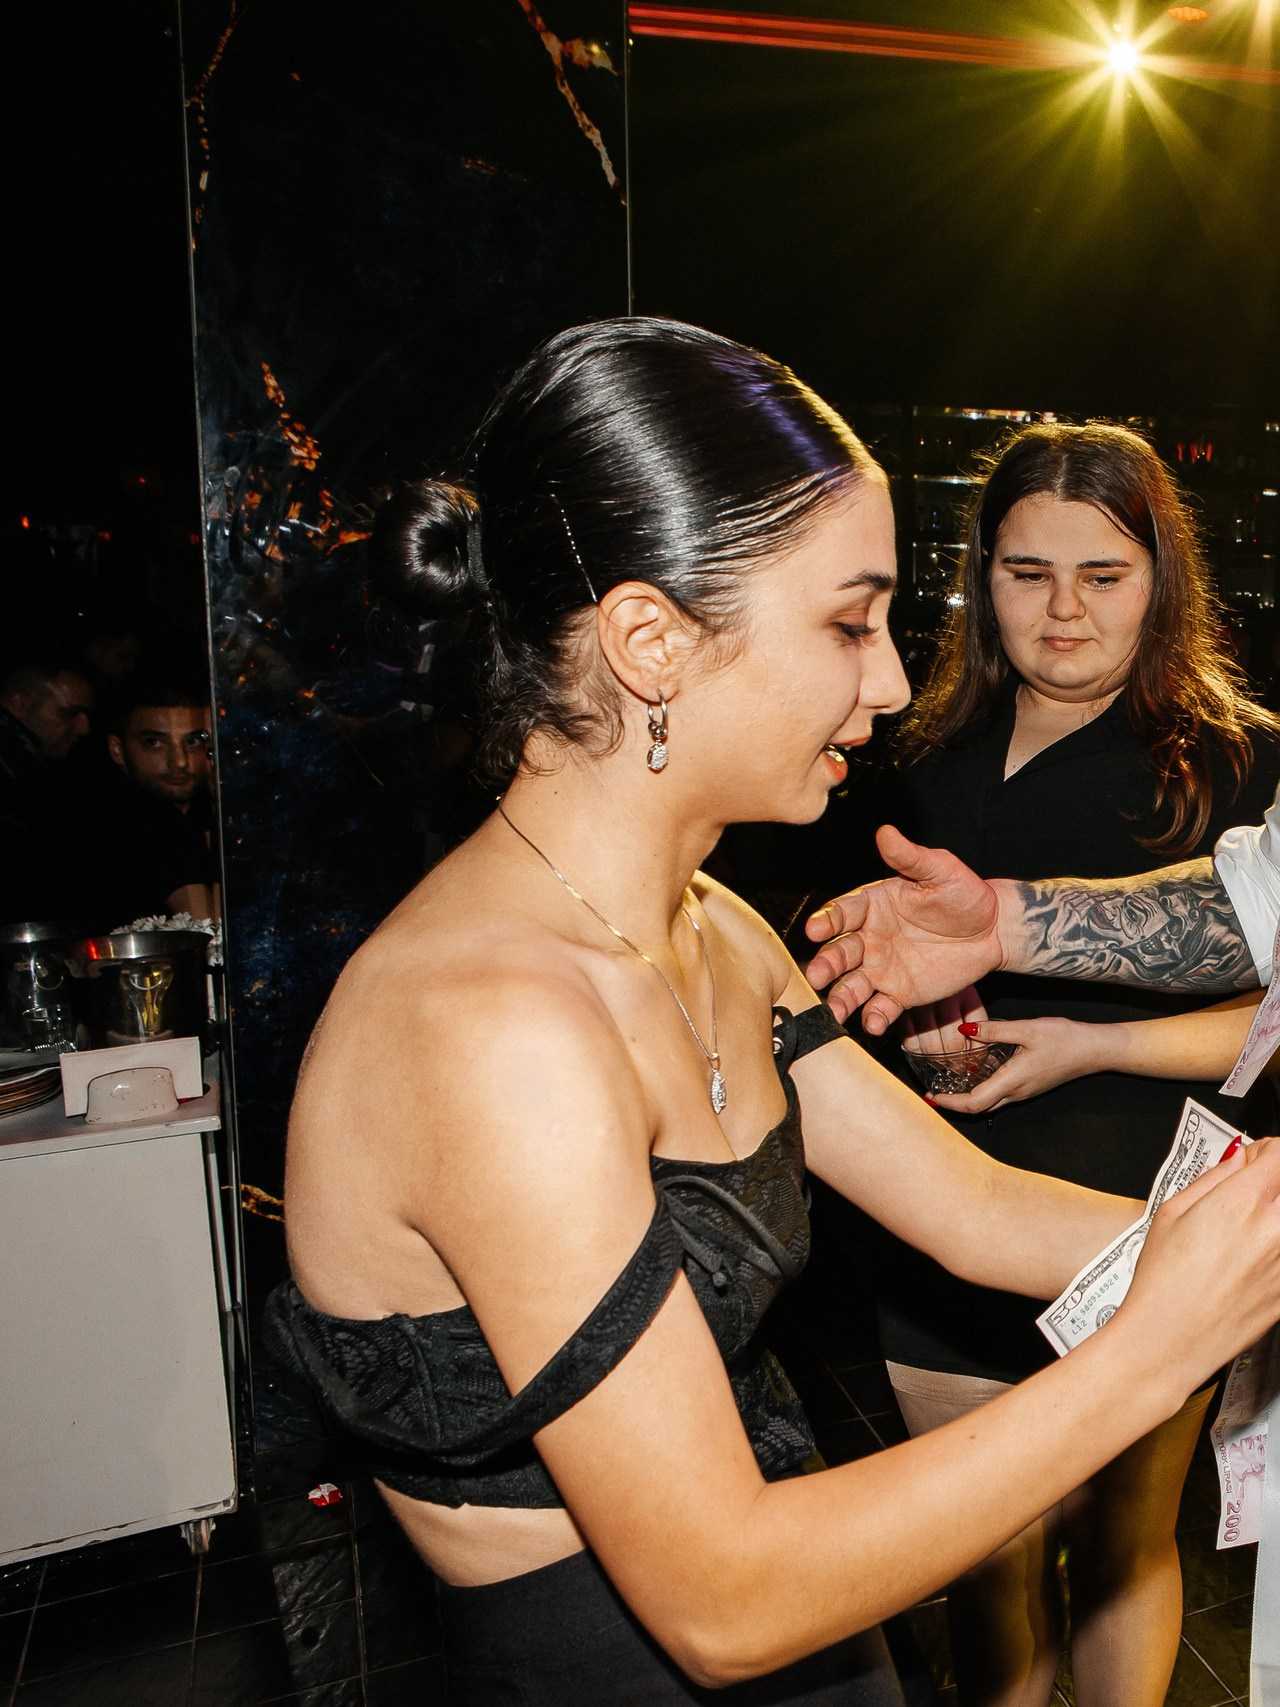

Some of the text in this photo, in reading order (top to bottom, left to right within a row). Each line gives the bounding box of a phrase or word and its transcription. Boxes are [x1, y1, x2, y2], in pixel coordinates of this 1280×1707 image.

[1226, 1051, 1250, 1090] 200
[1181, 1113, 1202, 1150] 50
[1183, 1137, 1206, 1181] STATES
[1051, 1290, 1083, 1325] 50
[1223, 1500, 1242, 1542] 200
